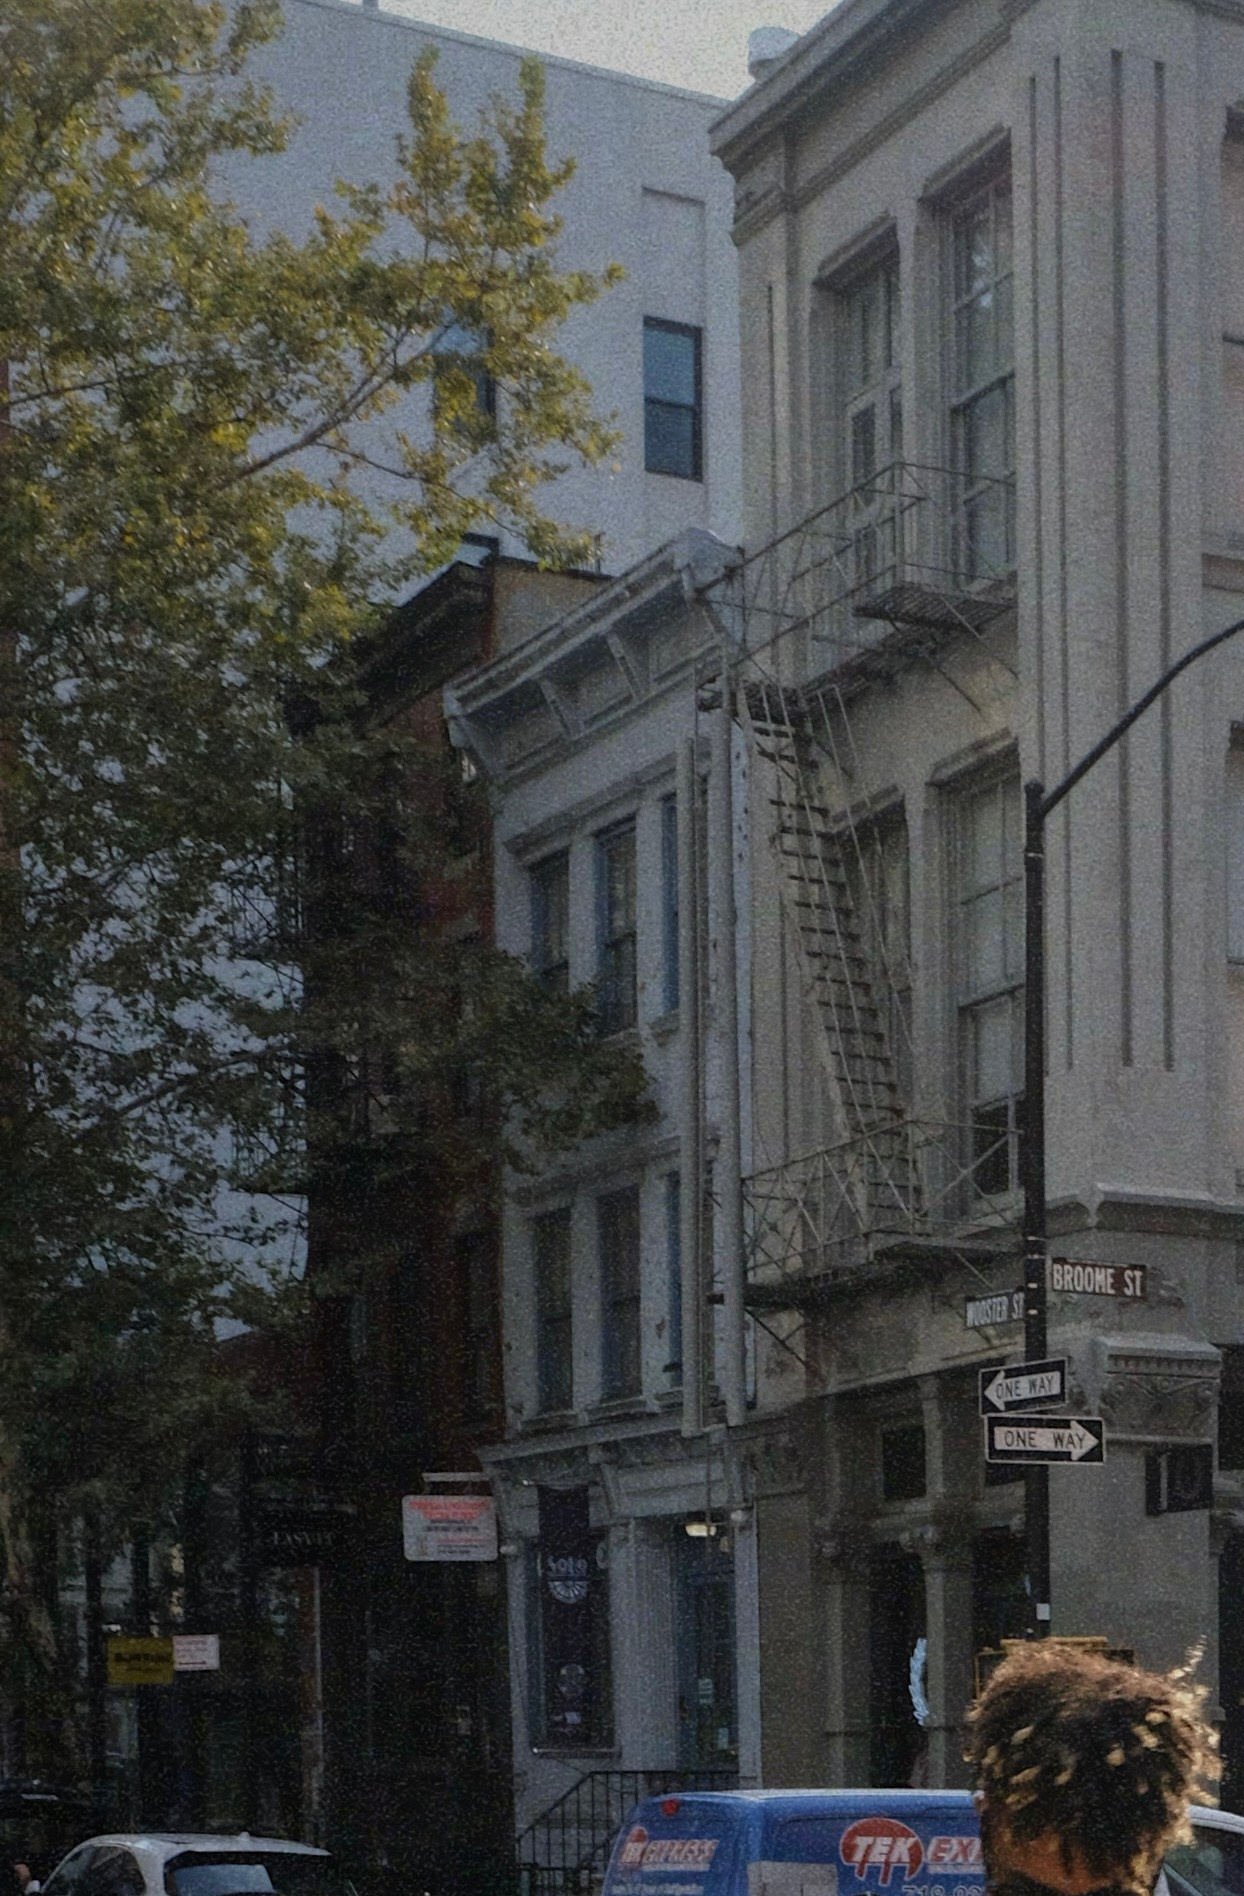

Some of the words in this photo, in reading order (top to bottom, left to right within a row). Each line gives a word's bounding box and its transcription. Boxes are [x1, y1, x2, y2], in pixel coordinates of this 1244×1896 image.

[1053, 1264, 1116, 1295] BROOME
[1123, 1269, 1143, 1297] ST
[966, 1296, 1009, 1328] WOOSTER
[1012, 1292, 1025, 1320] ST
[995, 1380, 1022, 1400] ONE
[1028, 1375, 1055, 1394] WAY
[1004, 1430, 1038, 1448] ONE
[1052, 1432, 1087, 1449] WAY
[852, 1836, 918, 1863] TEK
